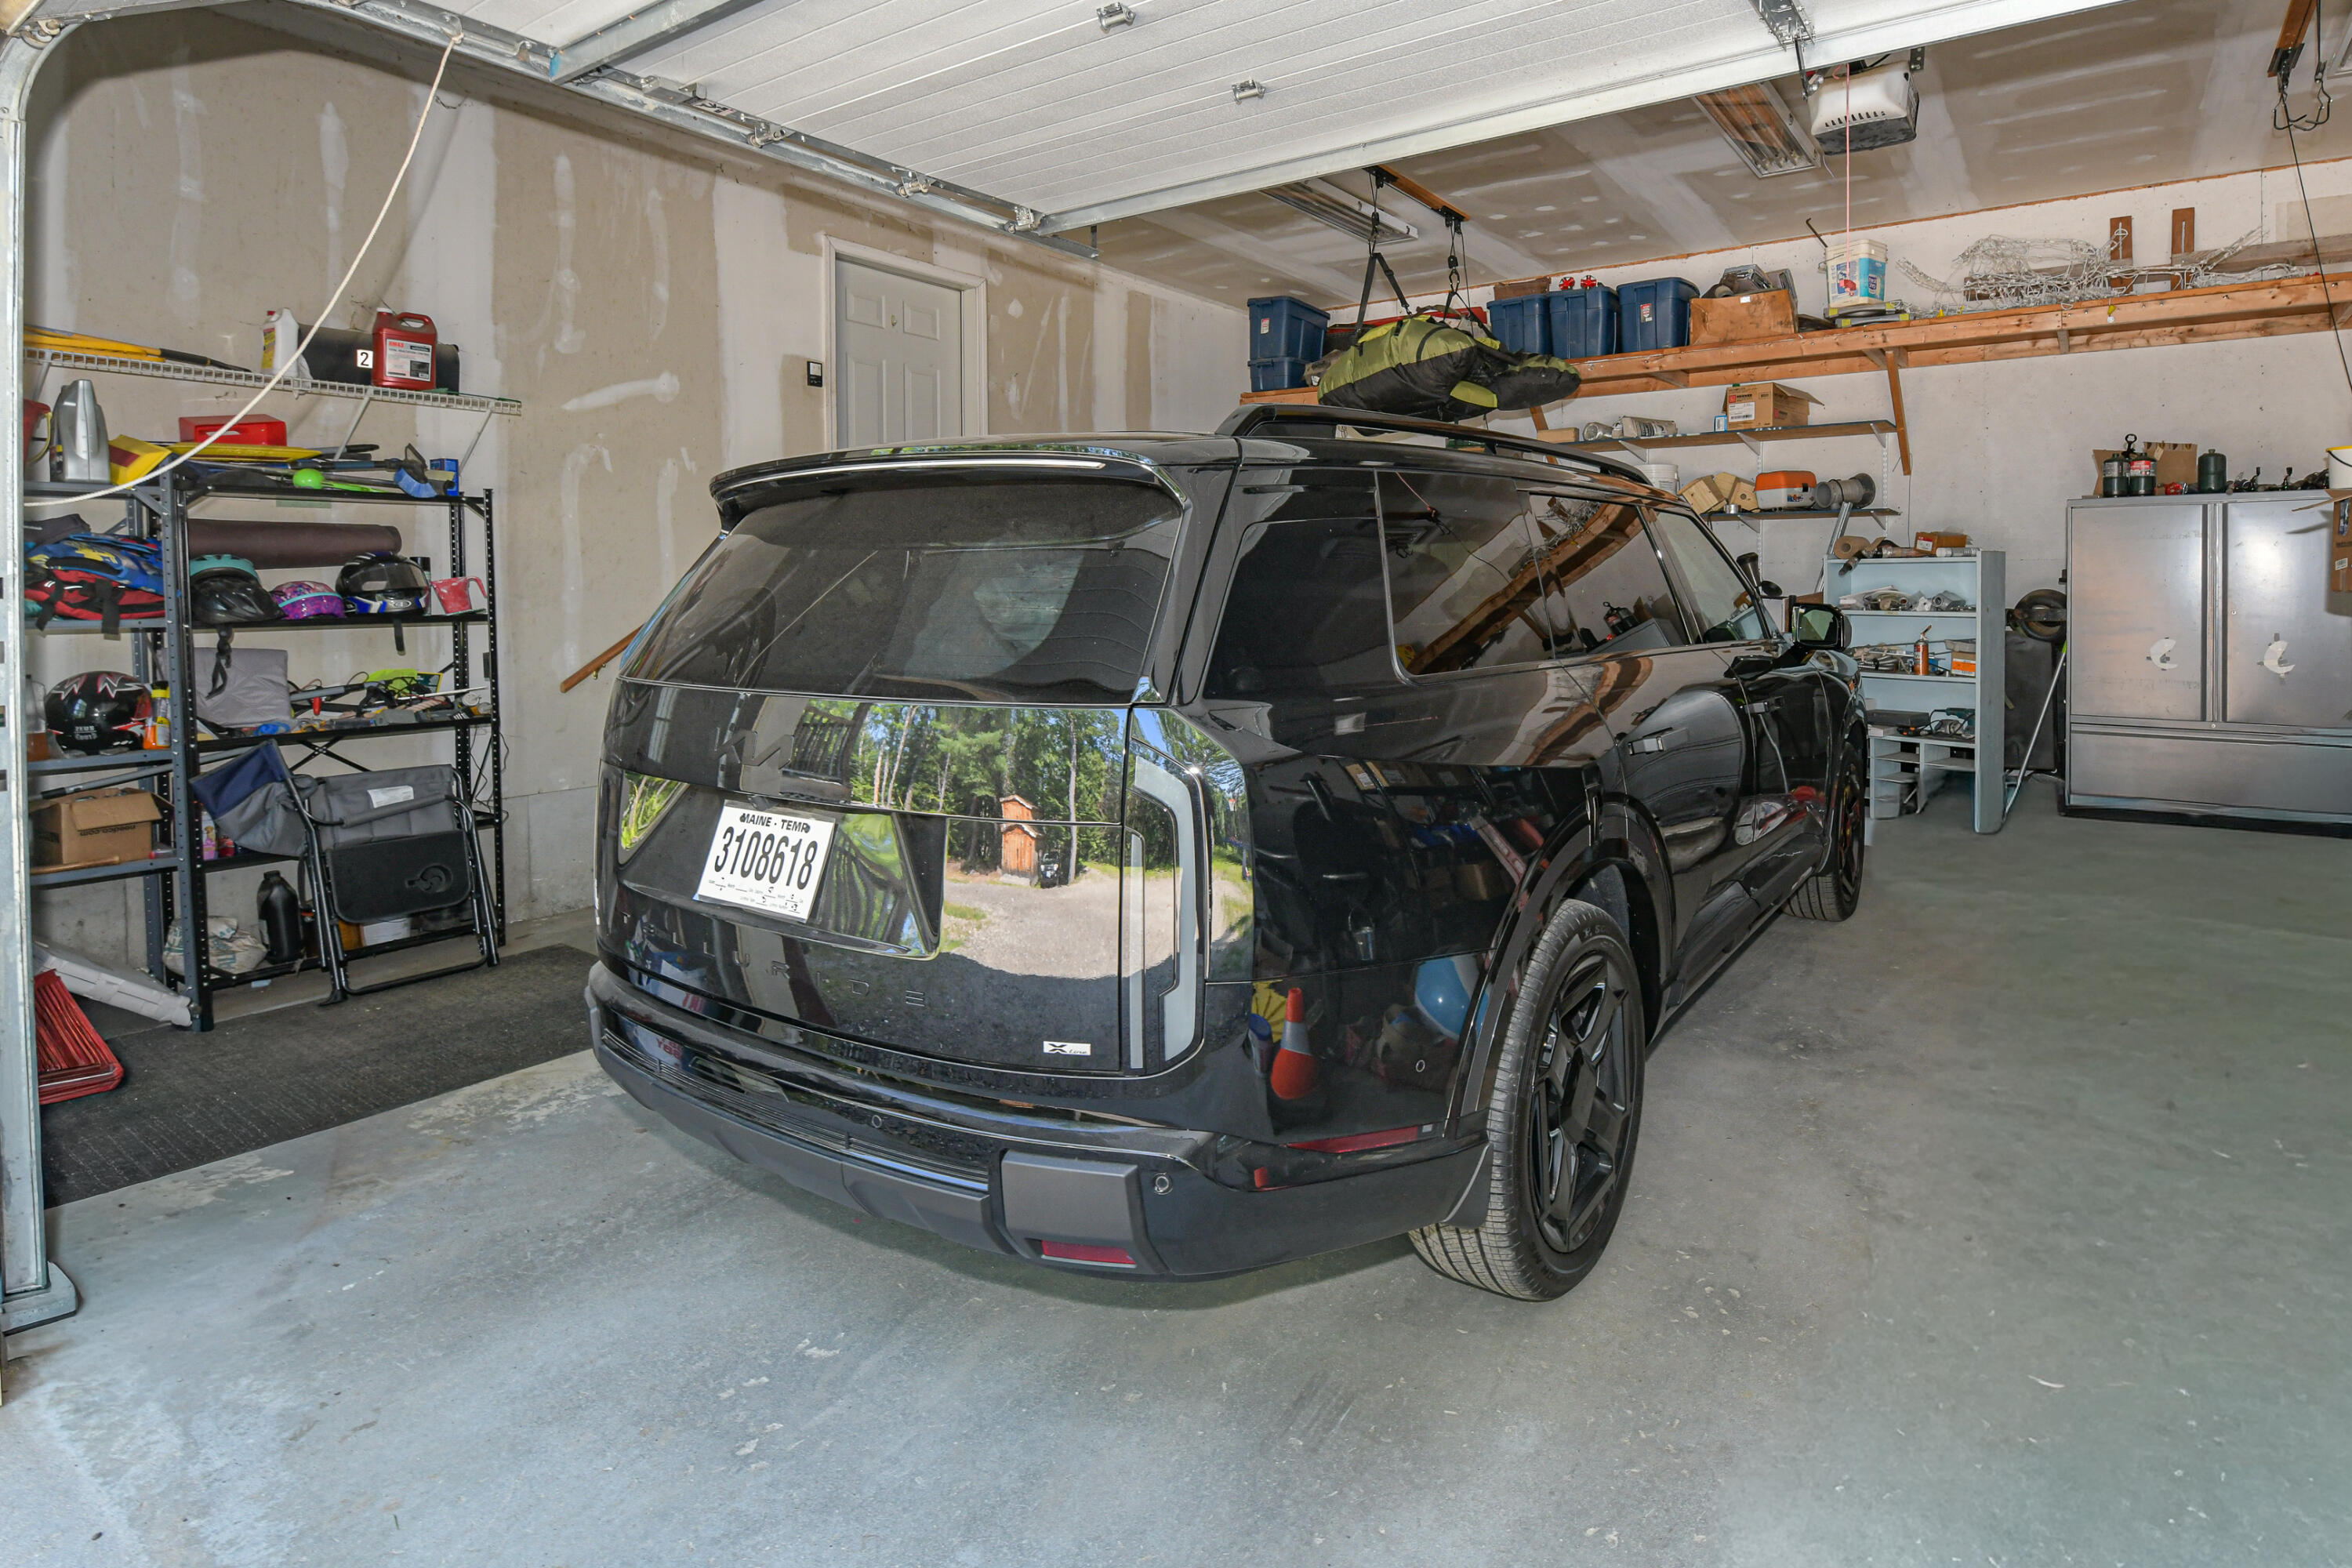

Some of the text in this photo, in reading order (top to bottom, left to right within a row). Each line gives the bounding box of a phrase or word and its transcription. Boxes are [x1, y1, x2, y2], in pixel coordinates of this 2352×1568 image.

[361, 352, 369, 367] 2
[739, 812, 772, 827] MAINE
[714, 826, 818, 890] 3108618
